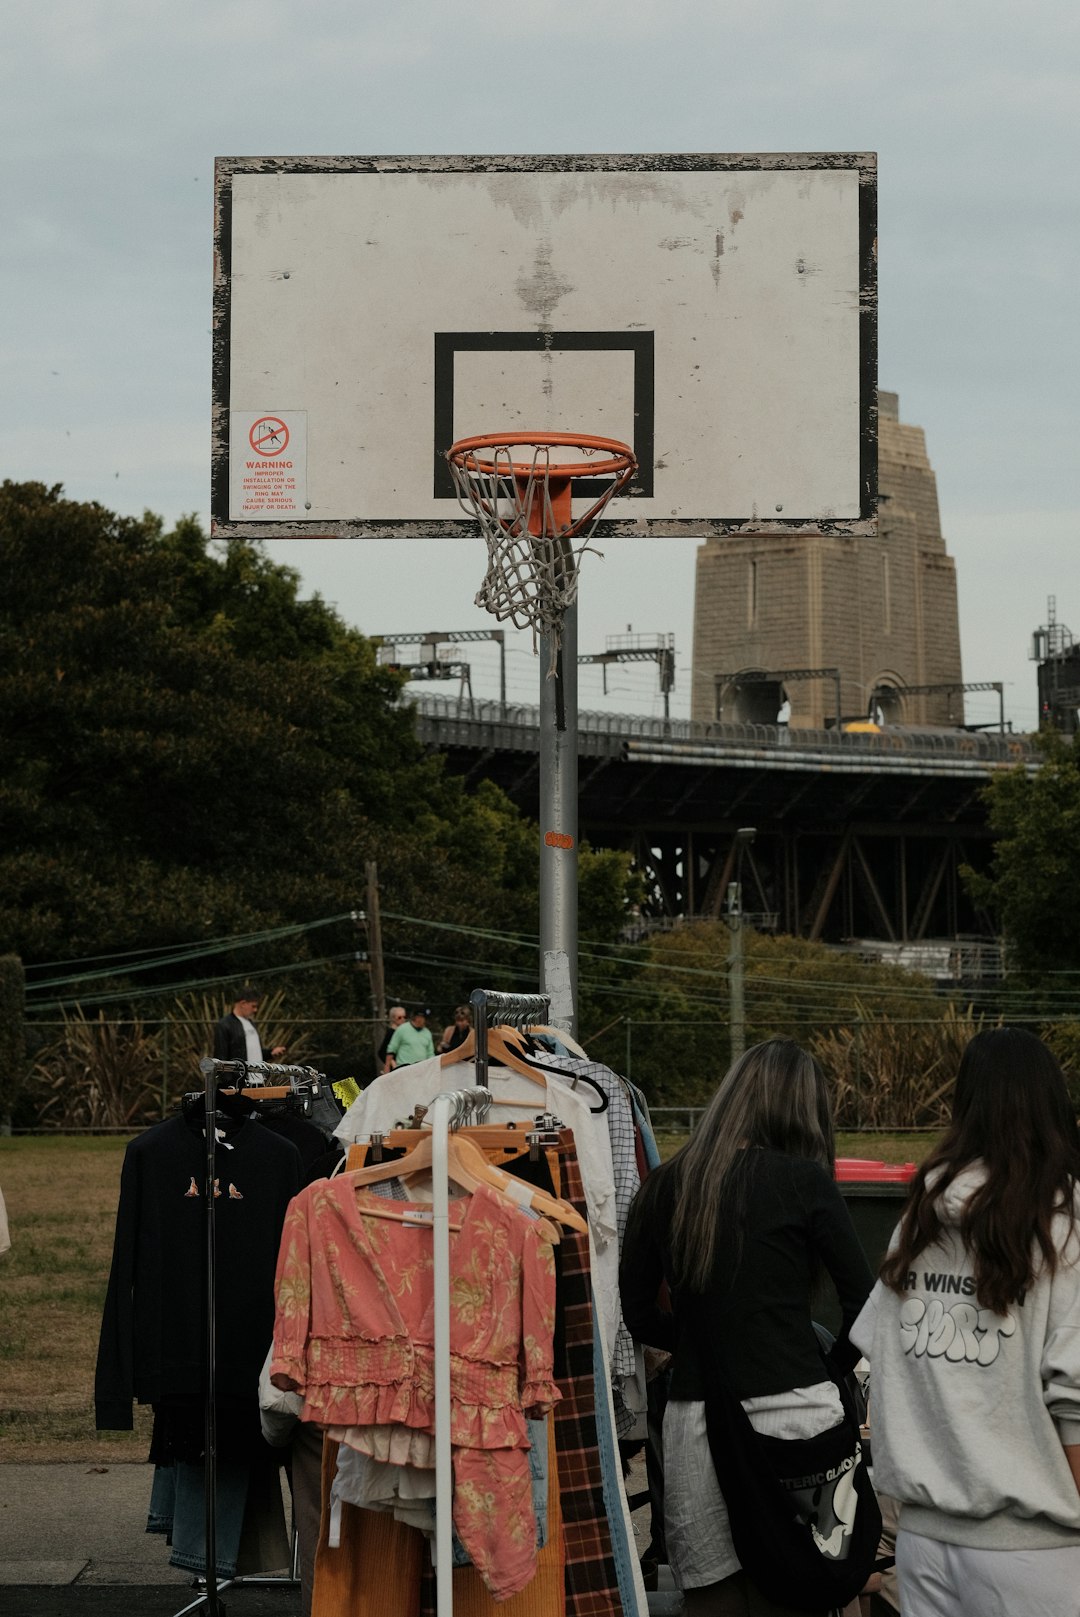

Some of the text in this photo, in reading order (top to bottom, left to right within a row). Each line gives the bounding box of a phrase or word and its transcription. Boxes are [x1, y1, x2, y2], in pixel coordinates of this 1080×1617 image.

[246, 461, 293, 469] WARNING
[903, 1271, 917, 1291] R
[900, 1297, 1016, 1368] SPORT
